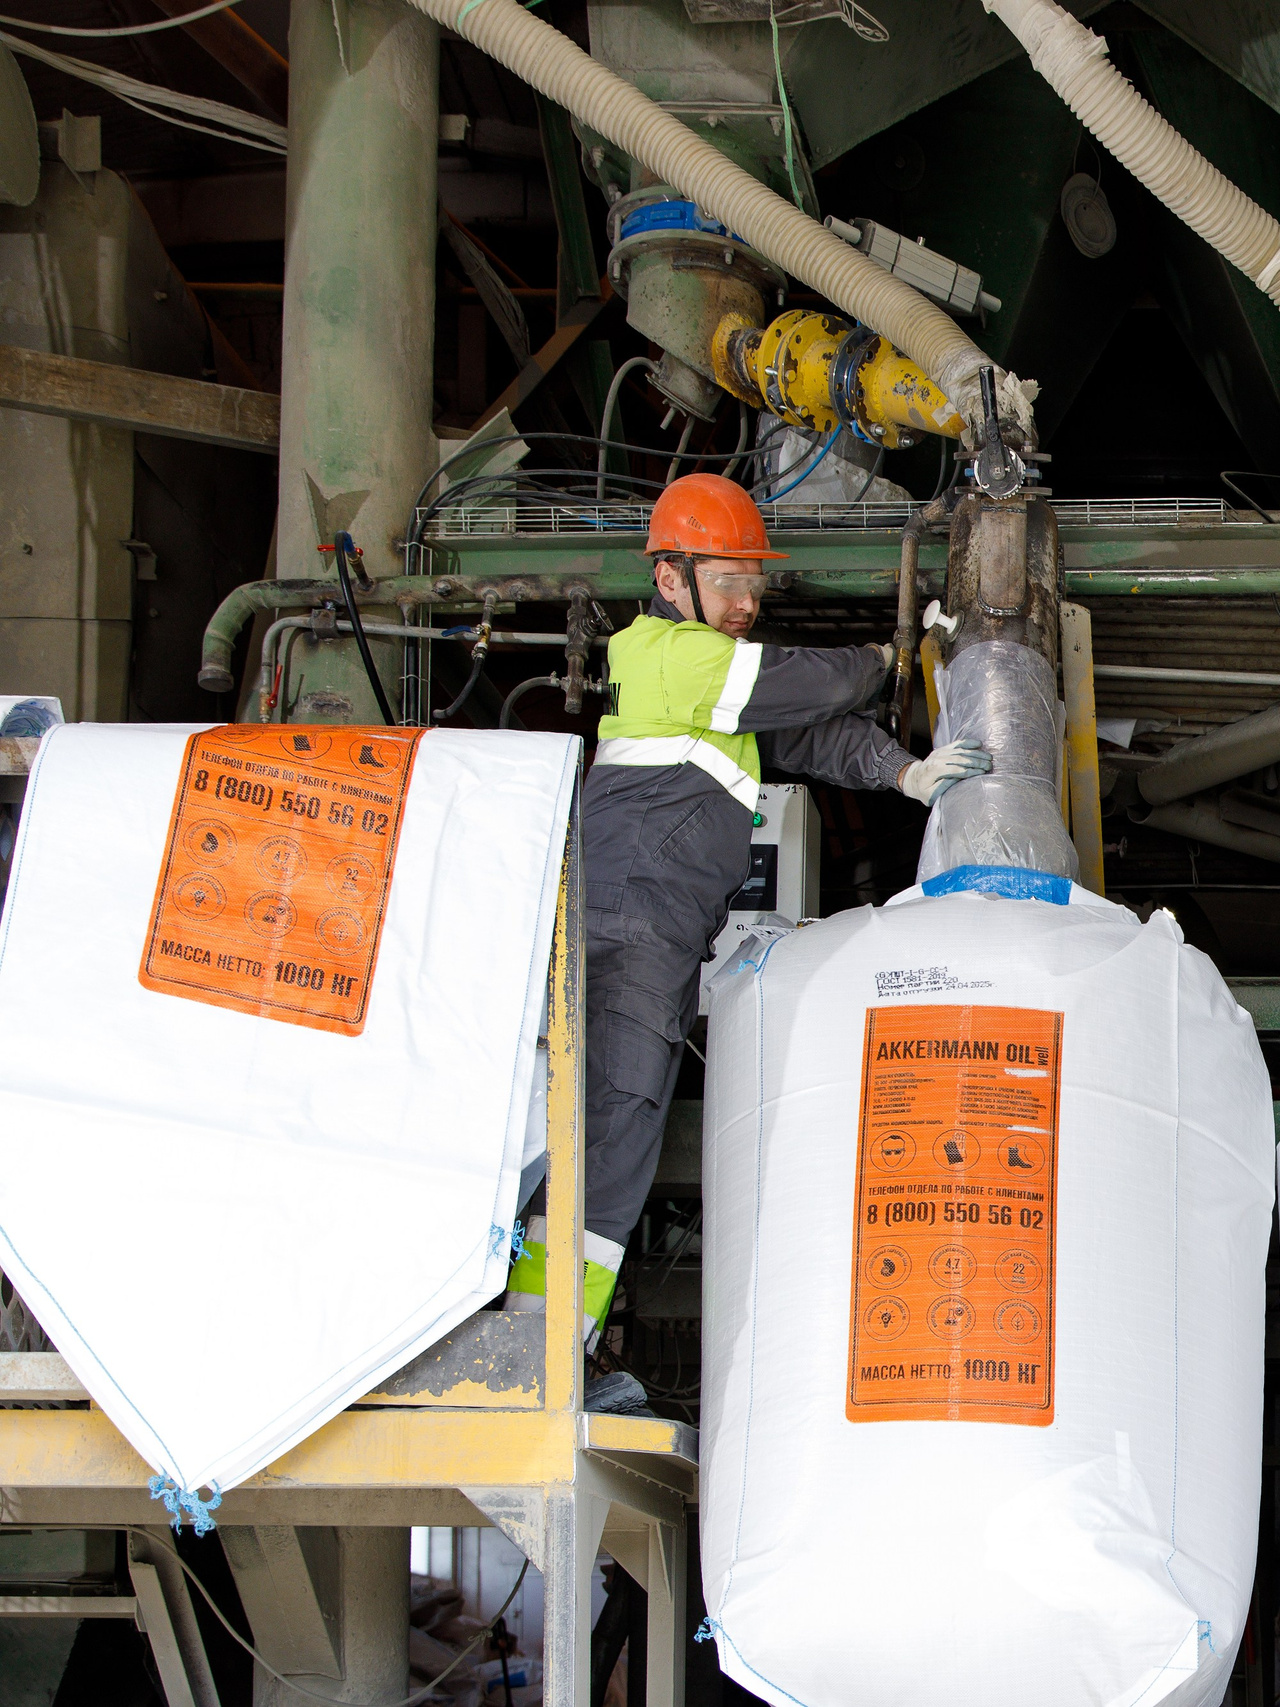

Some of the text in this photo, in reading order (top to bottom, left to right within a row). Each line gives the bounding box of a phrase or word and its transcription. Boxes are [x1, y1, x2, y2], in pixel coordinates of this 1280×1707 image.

[201, 750, 243, 769] ТЕЛЕФОН
[245, 762, 280, 779] ОТДЕЛА
[297, 773, 328, 790] РАБОТЕ
[194, 769, 389, 836] 8 (800) 550 56 02
[345, 868, 359, 881] 22
[160, 939, 212, 966] МАССА
[274, 960, 326, 991] 1000
[876, 1039, 1049, 1066] AKKERMANN OIL well
[868, 1185, 905, 1196] ТЕЛЕФОН
[907, 1184, 939, 1195] ОТДЕЛА
[941, 1185, 952, 1194] ПО
[955, 1185, 985, 1196] РАБОТЕ
[988, 1187, 993, 1196] С
[867, 1201, 1044, 1230] 8 (800) 550 56 02
[1013, 1262, 1025, 1274] 22
[861, 1364, 905, 1381] МАССА
[964, 1358, 1010, 1382] 1000
